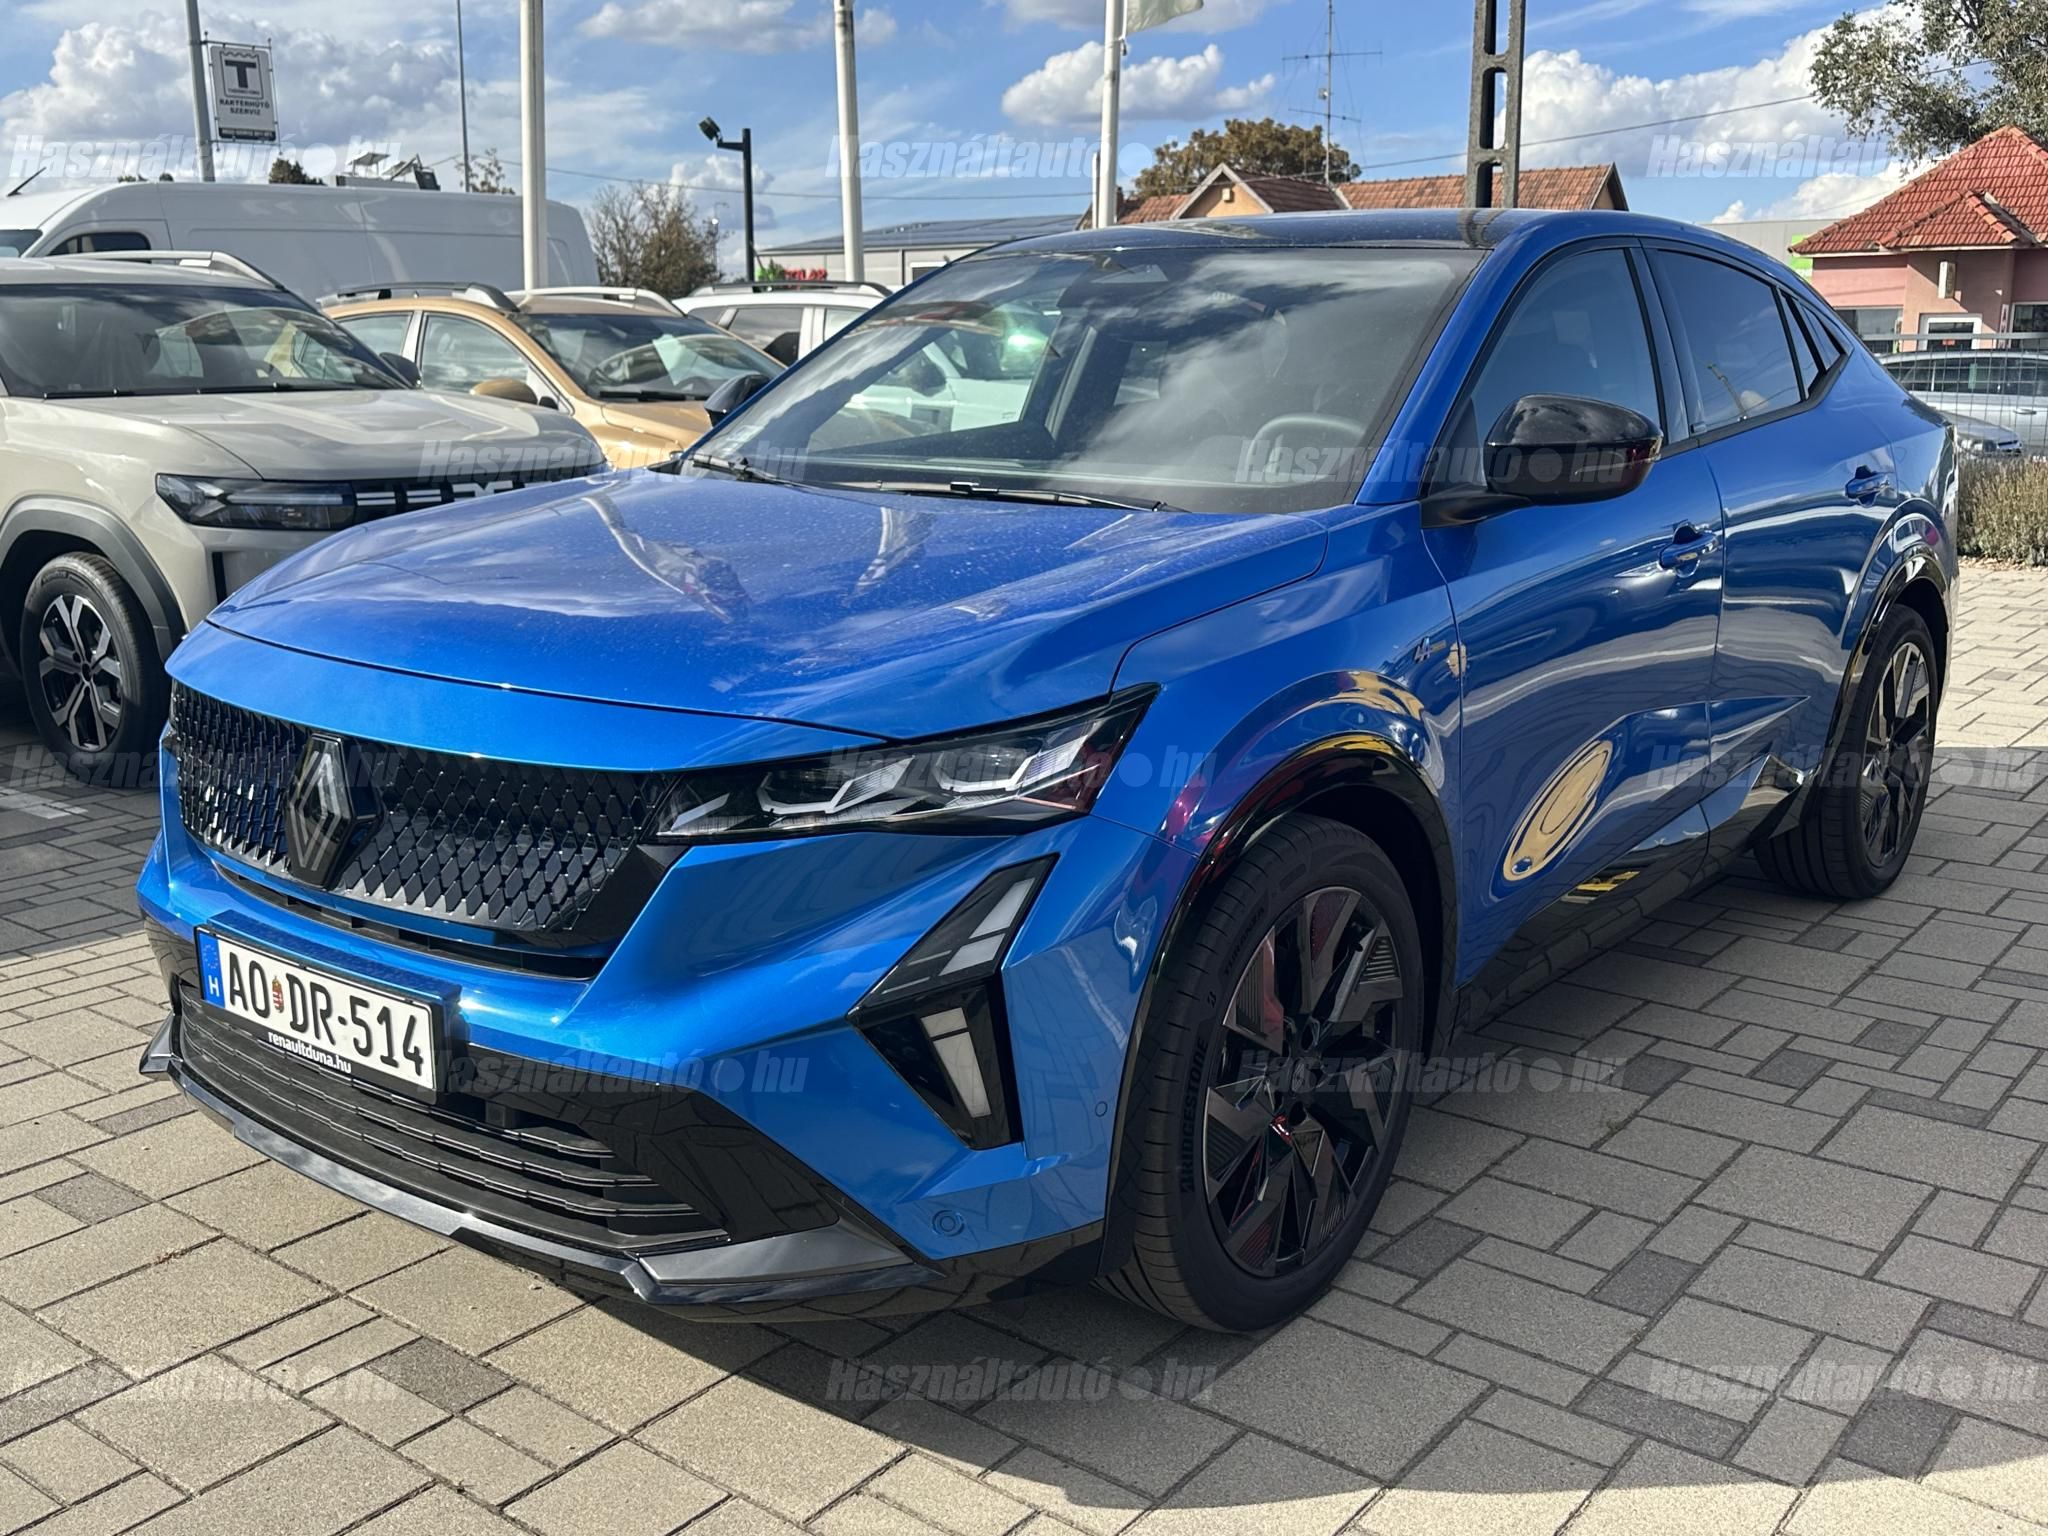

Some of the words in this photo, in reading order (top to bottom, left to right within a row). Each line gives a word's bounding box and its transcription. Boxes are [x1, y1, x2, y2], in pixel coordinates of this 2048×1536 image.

[224, 60, 257, 88] T
[209, 975, 220, 997] H
[228, 951, 271, 1019] AO
[285, 973, 424, 1077] DR-514
[267, 1031, 352, 1074] renaultduna.hu
